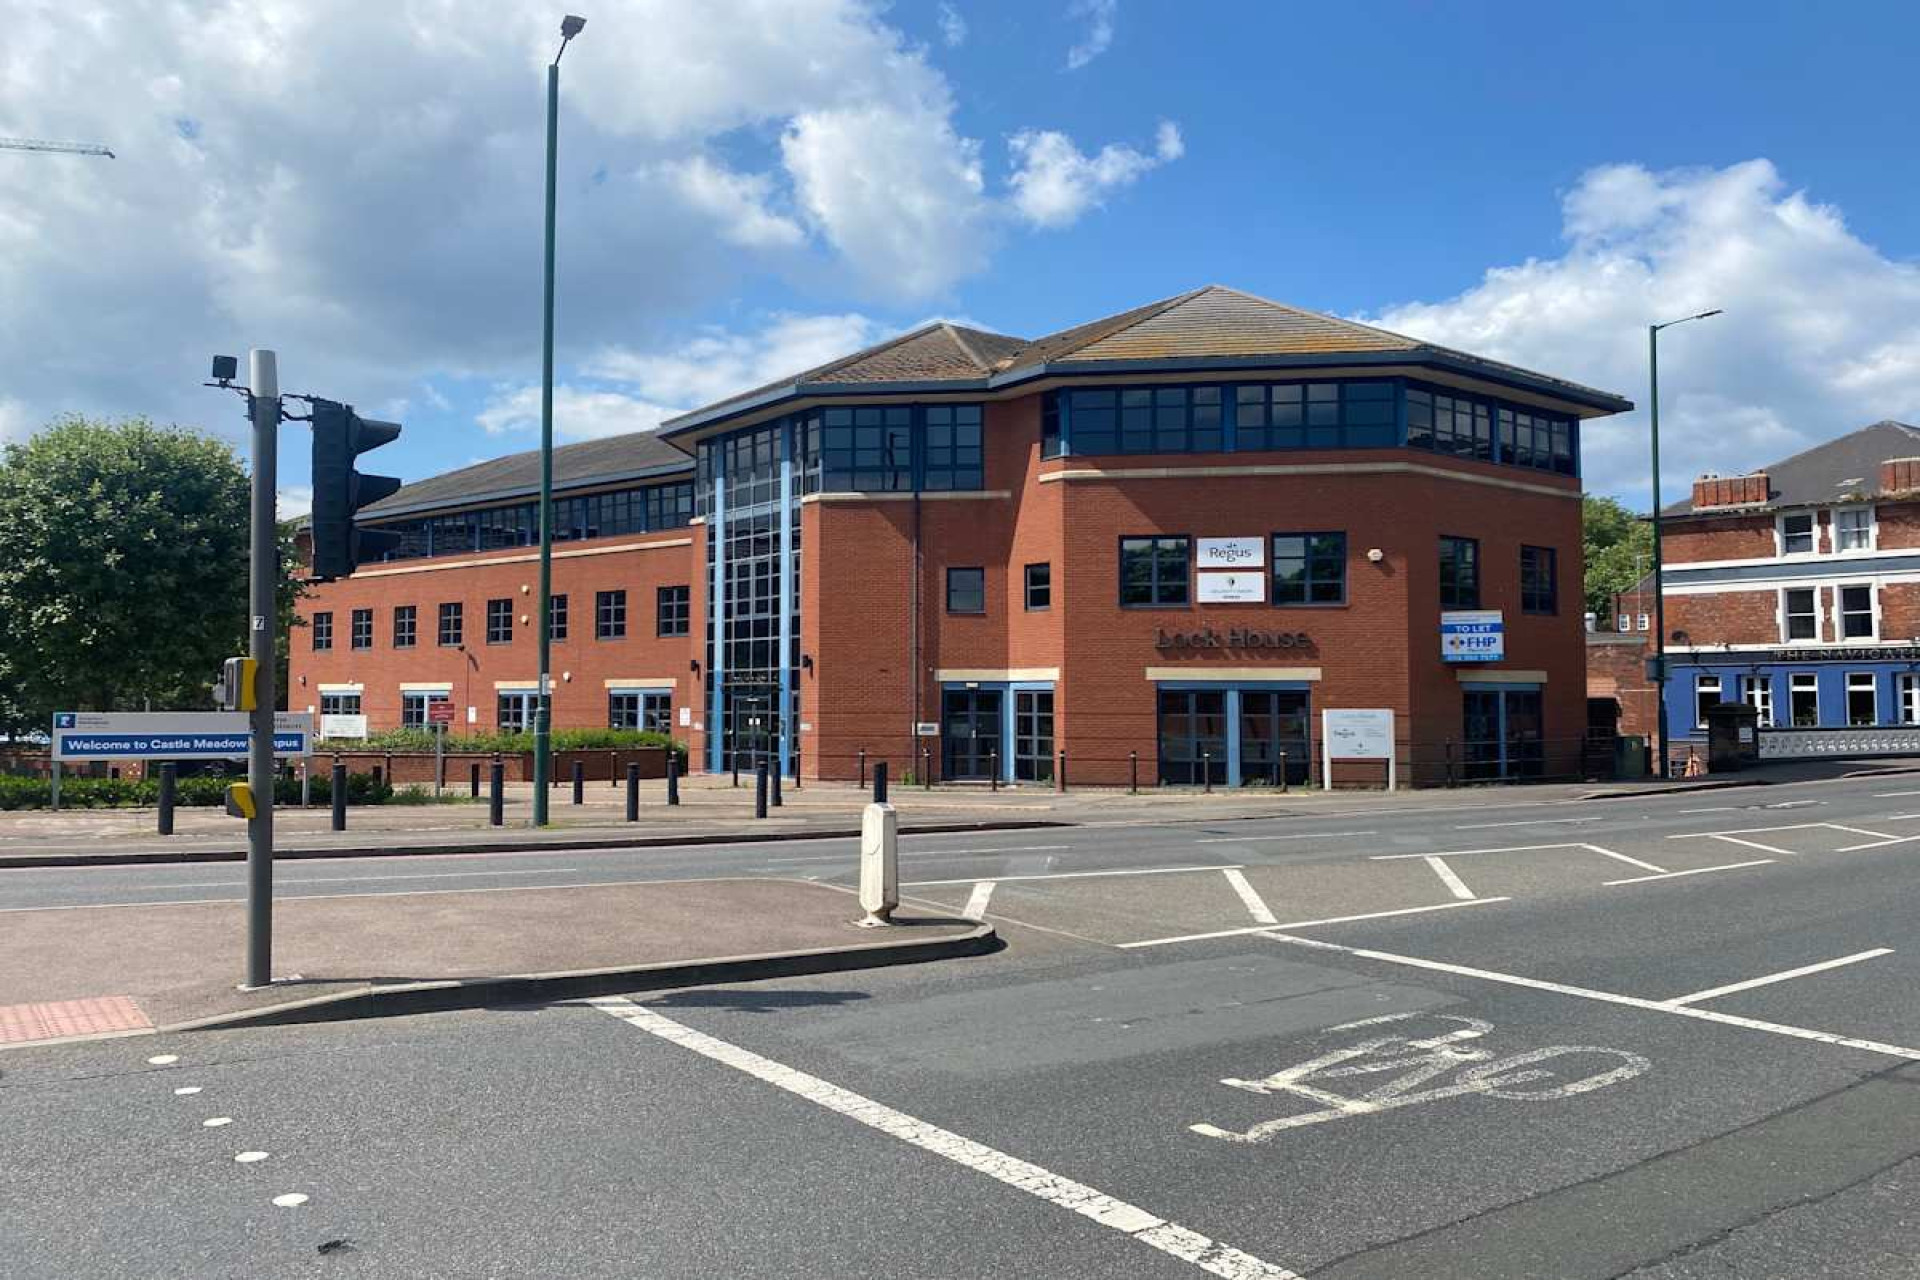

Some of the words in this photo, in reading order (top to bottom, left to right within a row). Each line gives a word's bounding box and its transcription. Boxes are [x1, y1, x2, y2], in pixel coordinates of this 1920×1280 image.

[1208, 546, 1253, 563] Regus
[1153, 627, 1218, 648] Lock
[1228, 627, 1310, 648] House
[1466, 636, 1497, 648] FHP
[1774, 648, 1813, 661] THE
[67, 739, 131, 751] Welcome
[133, 739, 148, 750] to
[150, 738, 191, 750] Castle
[193, 738, 248, 750] Meadow
